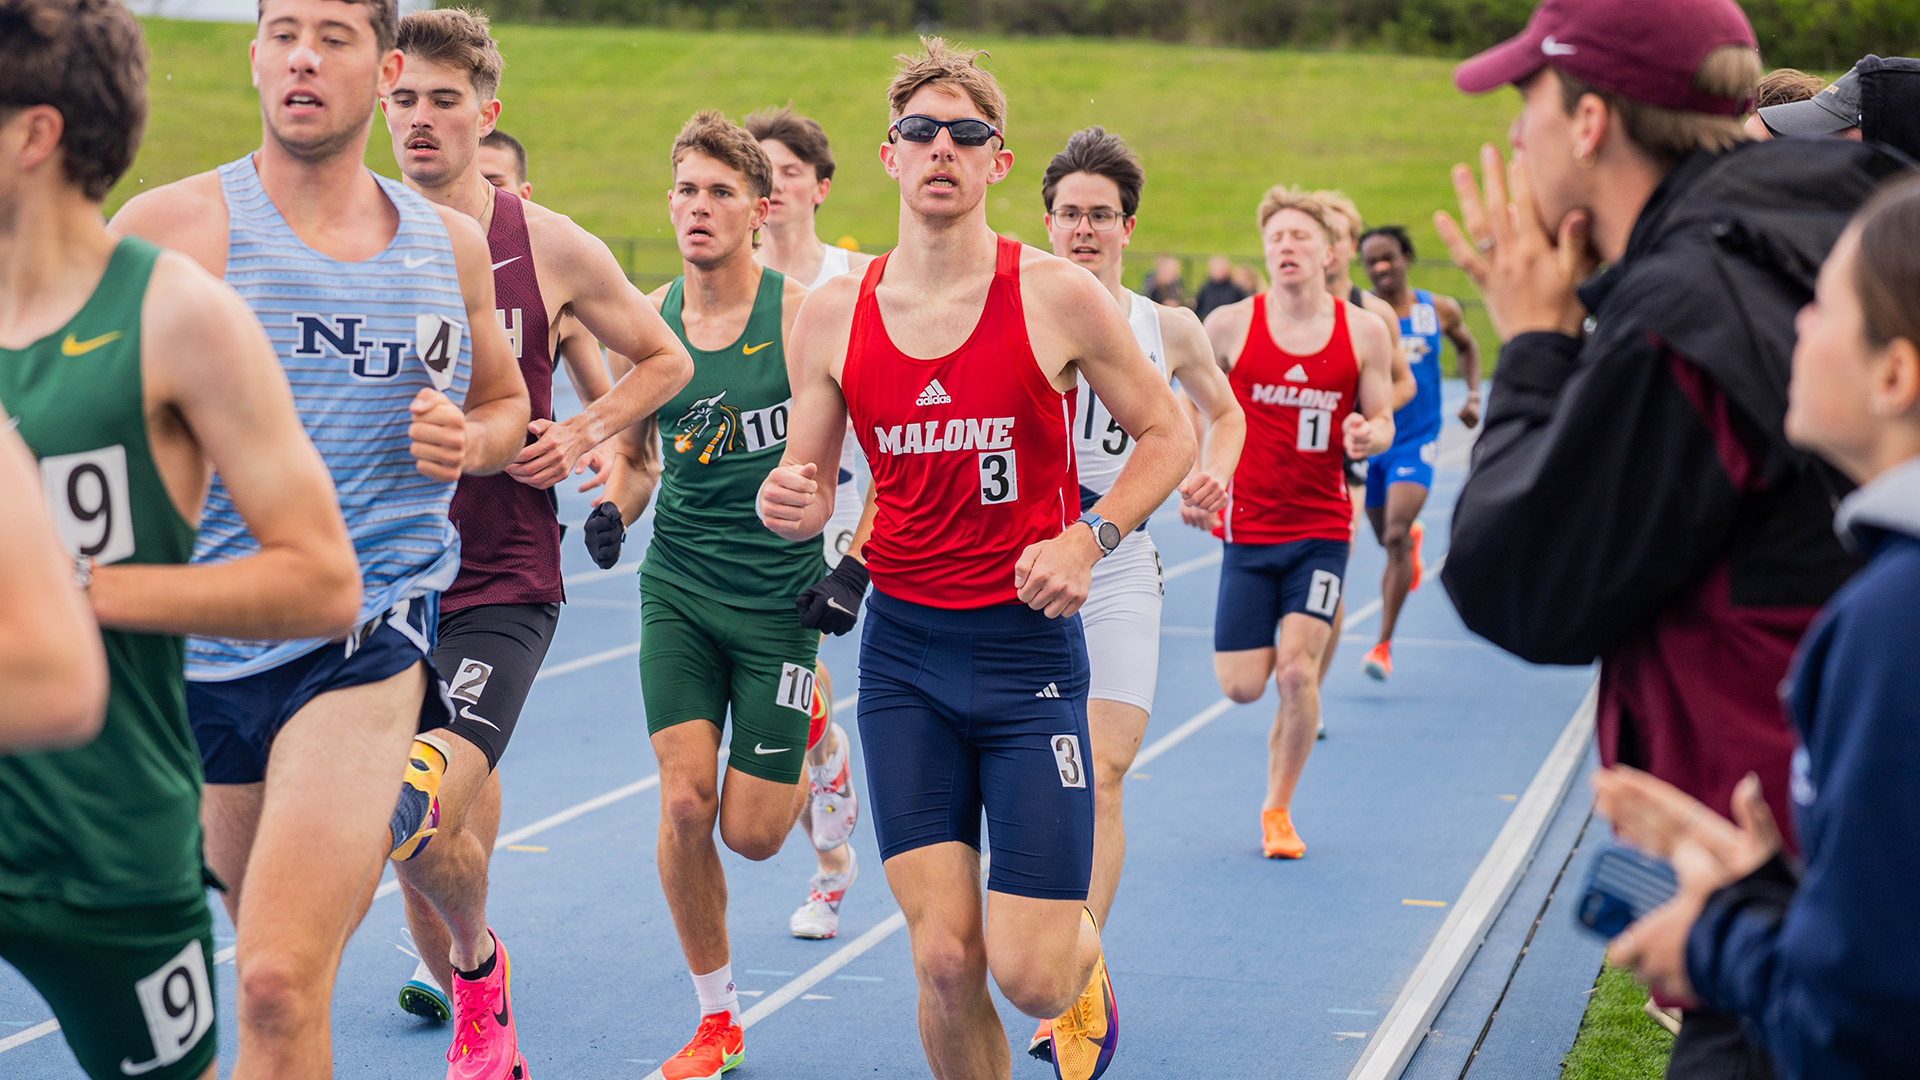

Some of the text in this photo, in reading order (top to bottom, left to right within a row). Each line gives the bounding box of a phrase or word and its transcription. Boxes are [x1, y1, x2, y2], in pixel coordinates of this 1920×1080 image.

[293, 312, 411, 382] NU
[424, 321, 450, 373] 4
[915, 395, 952, 407] adidas
[1251, 383, 1343, 412] MALONE
[746, 405, 789, 448] 10
[874, 416, 1015, 456] MALONE
[1307, 414, 1319, 447] 1
[981, 454, 1010, 502] 3
[67, 463, 112, 556] 9
[834, 529, 855, 556] 6
[1320, 579, 1331, 609] 1
[452, 662, 489, 702] 2
[786, 666, 813, 710] 10
[1055, 737, 1080, 785] 3
[161, 966, 199, 1046] 9
